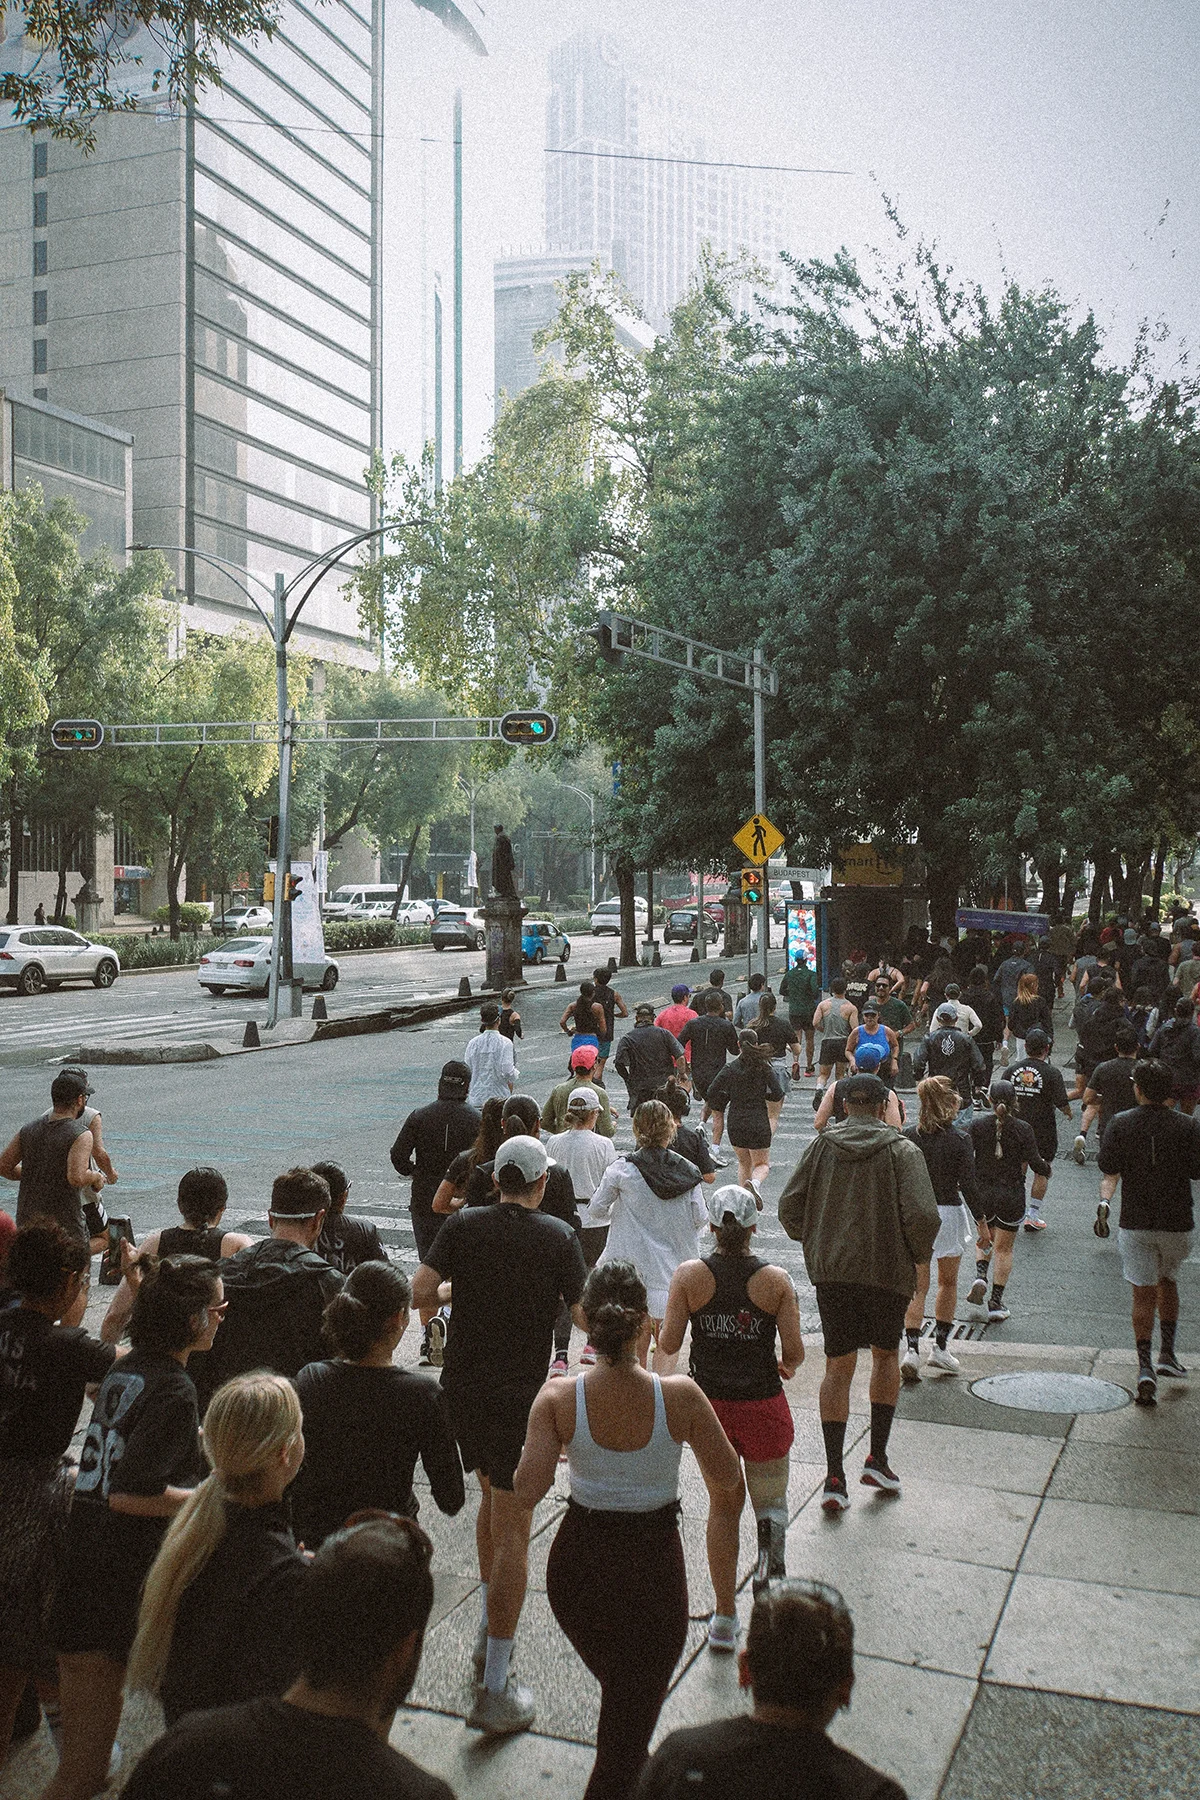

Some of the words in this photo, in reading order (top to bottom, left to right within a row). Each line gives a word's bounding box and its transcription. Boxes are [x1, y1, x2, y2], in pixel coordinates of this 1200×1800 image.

[844, 857, 873, 866] mart
[774, 868, 811, 878] BUDAPEST
[700, 1314, 736, 1333] FREAKS
[750, 1317, 764, 1334] RC
